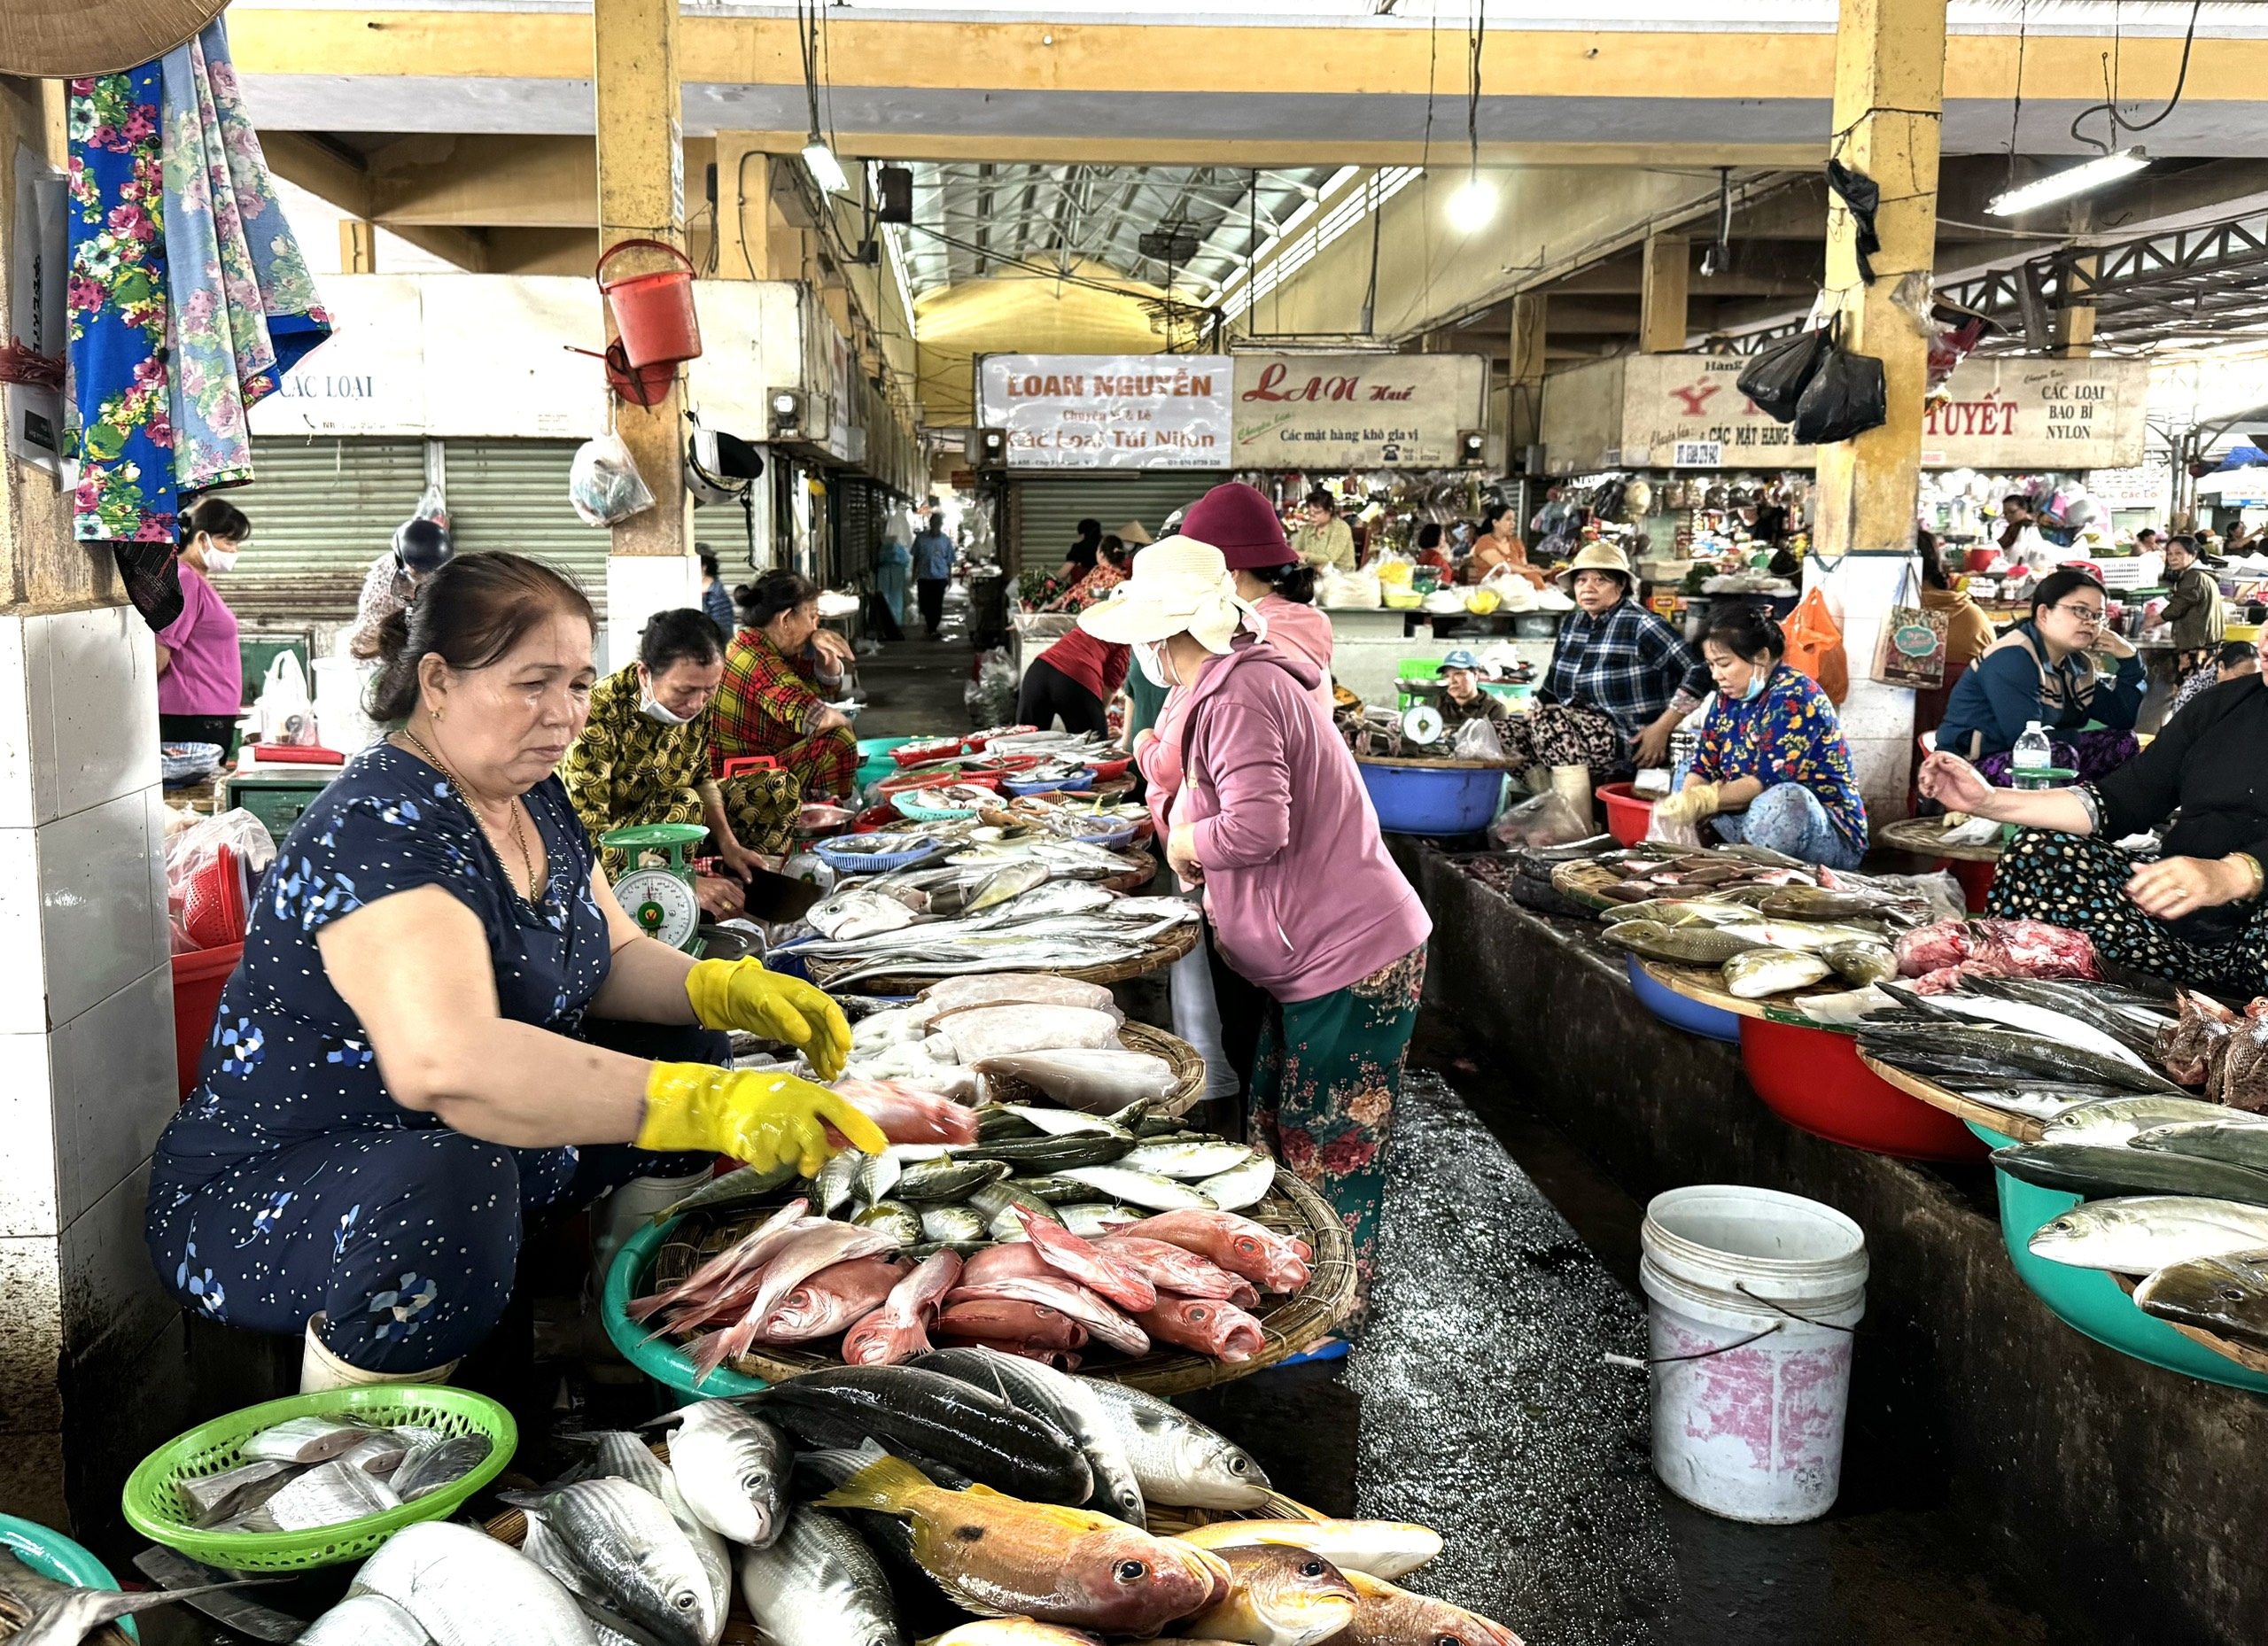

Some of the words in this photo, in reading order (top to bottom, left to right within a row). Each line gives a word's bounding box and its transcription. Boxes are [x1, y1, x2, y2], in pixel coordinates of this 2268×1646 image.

[1006, 375, 1084, 397] LOAN
[1093, 368, 1212, 397] NGUYỄN
[2041, 382, 2069, 400] CÁC
[2075, 385, 2105, 401] LOẠI
[2049, 405, 2075, 419] BAO
[2080, 401, 2093, 419] BÌ
[1113, 430, 1146, 448] Túi
[1280, 429, 1301, 441] Các
[1331, 429, 1360, 443] hàng
[1388, 429, 1405, 443] gia
[1709, 422, 1730, 446] CÁC
[1736, 423, 1758, 448] MẶT
[1761, 422, 1789, 445] HÀNG
[2046, 425, 2091, 439] NYLON
